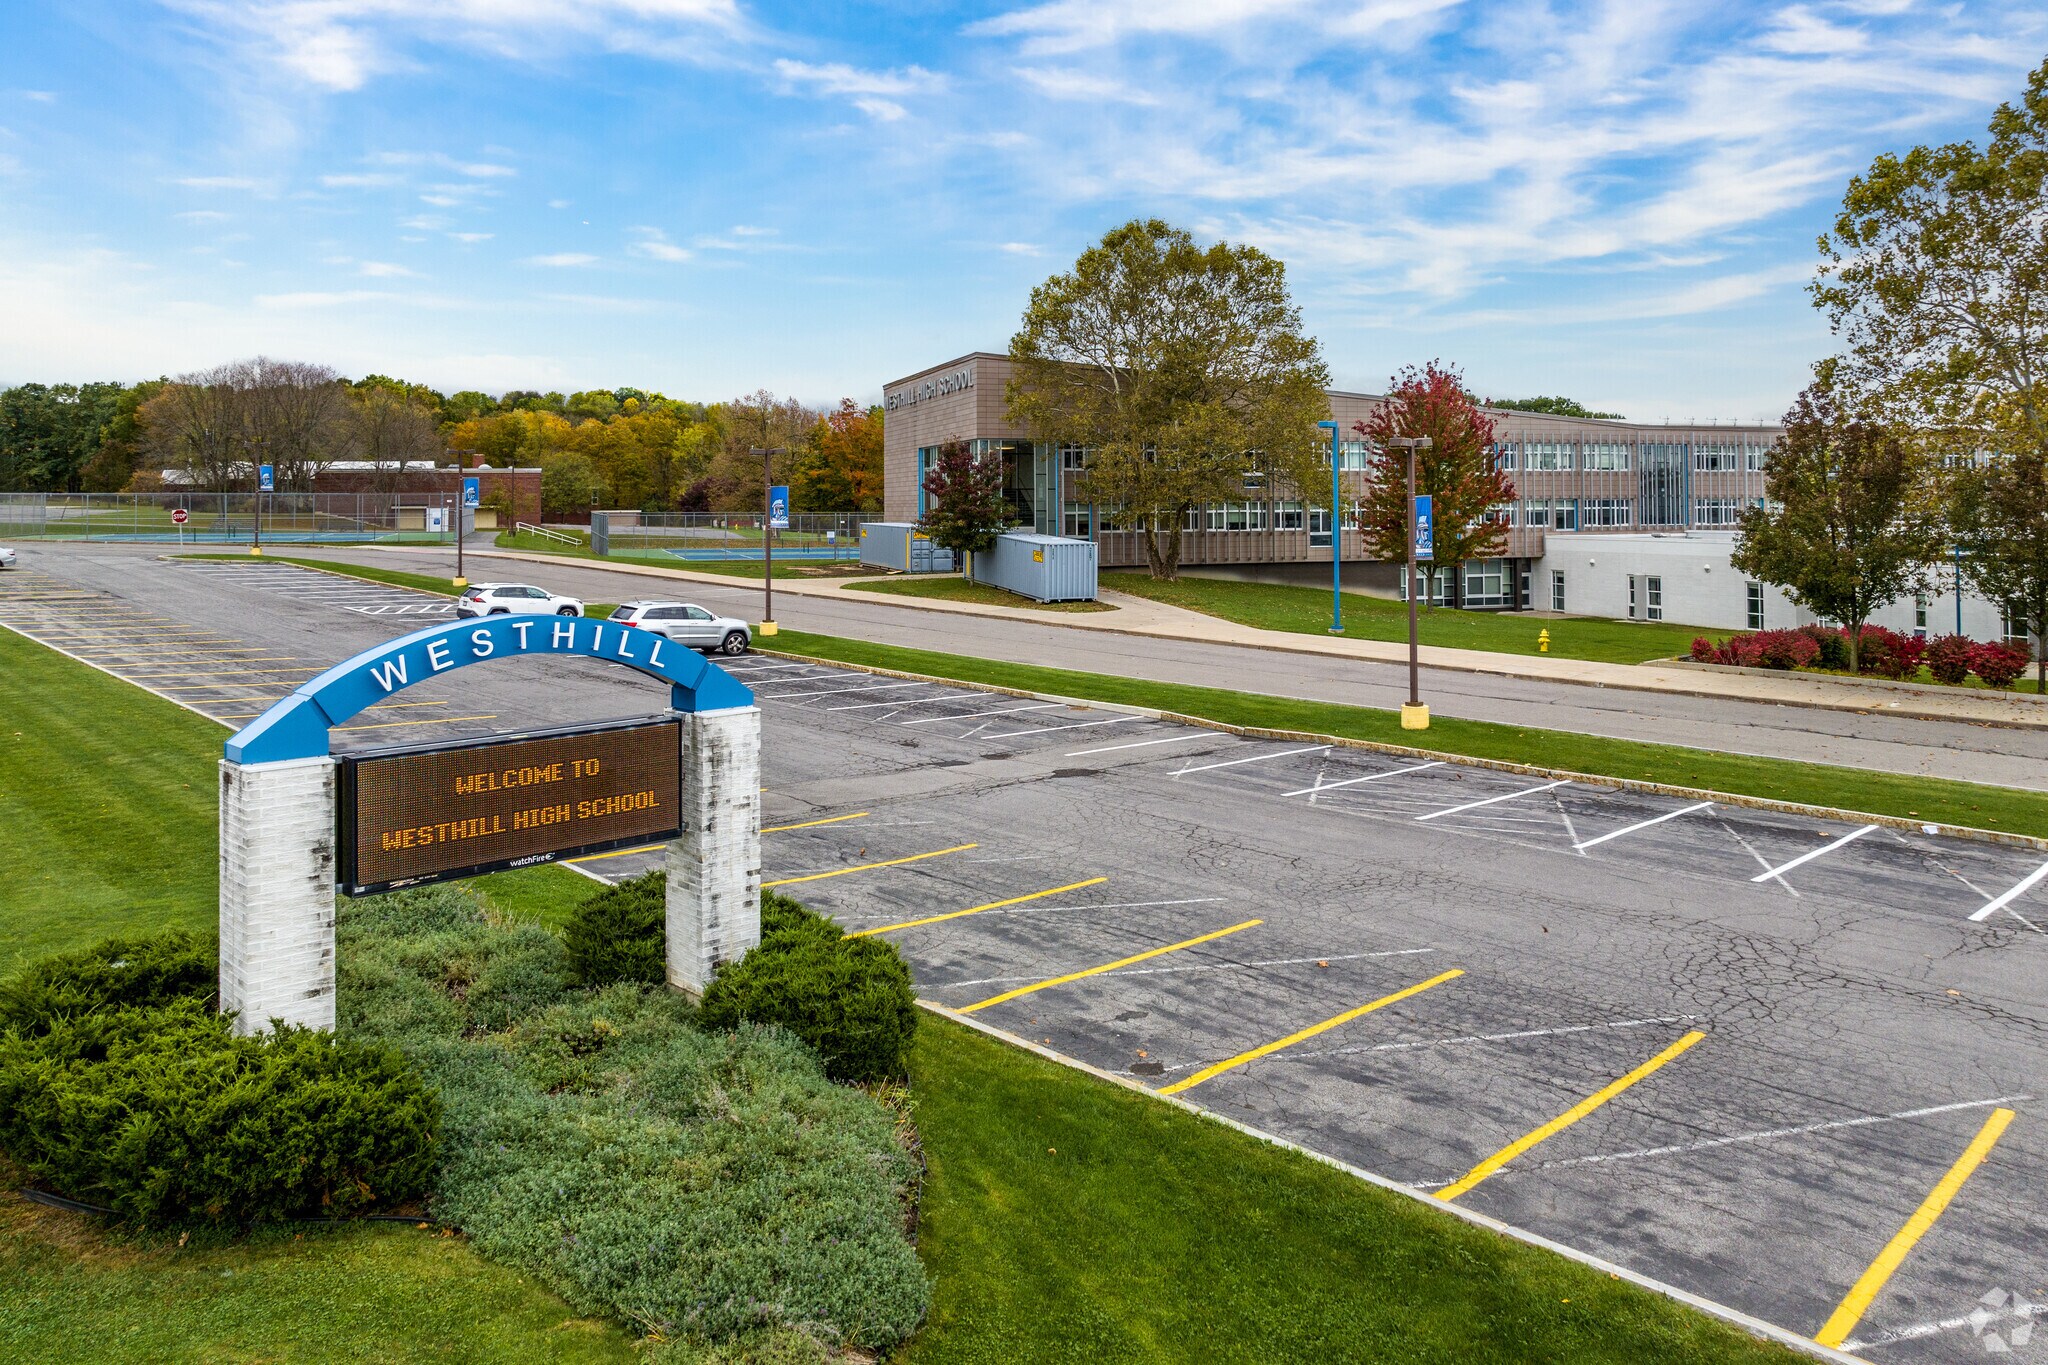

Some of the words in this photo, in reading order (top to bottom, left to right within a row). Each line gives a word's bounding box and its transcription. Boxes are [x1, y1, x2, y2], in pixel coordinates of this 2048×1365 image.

[918, 380, 937, 401] HIGH
[939, 369, 973, 395] SCHOOL
[370, 621, 665, 692] WESTHILL
[456, 762, 564, 795] WELCOME
[572, 758, 600, 778] TO
[382, 814, 506, 851] WESTHILL
[513, 803, 571, 831] HIGH
[577, 790, 660, 819] SCHOOL
